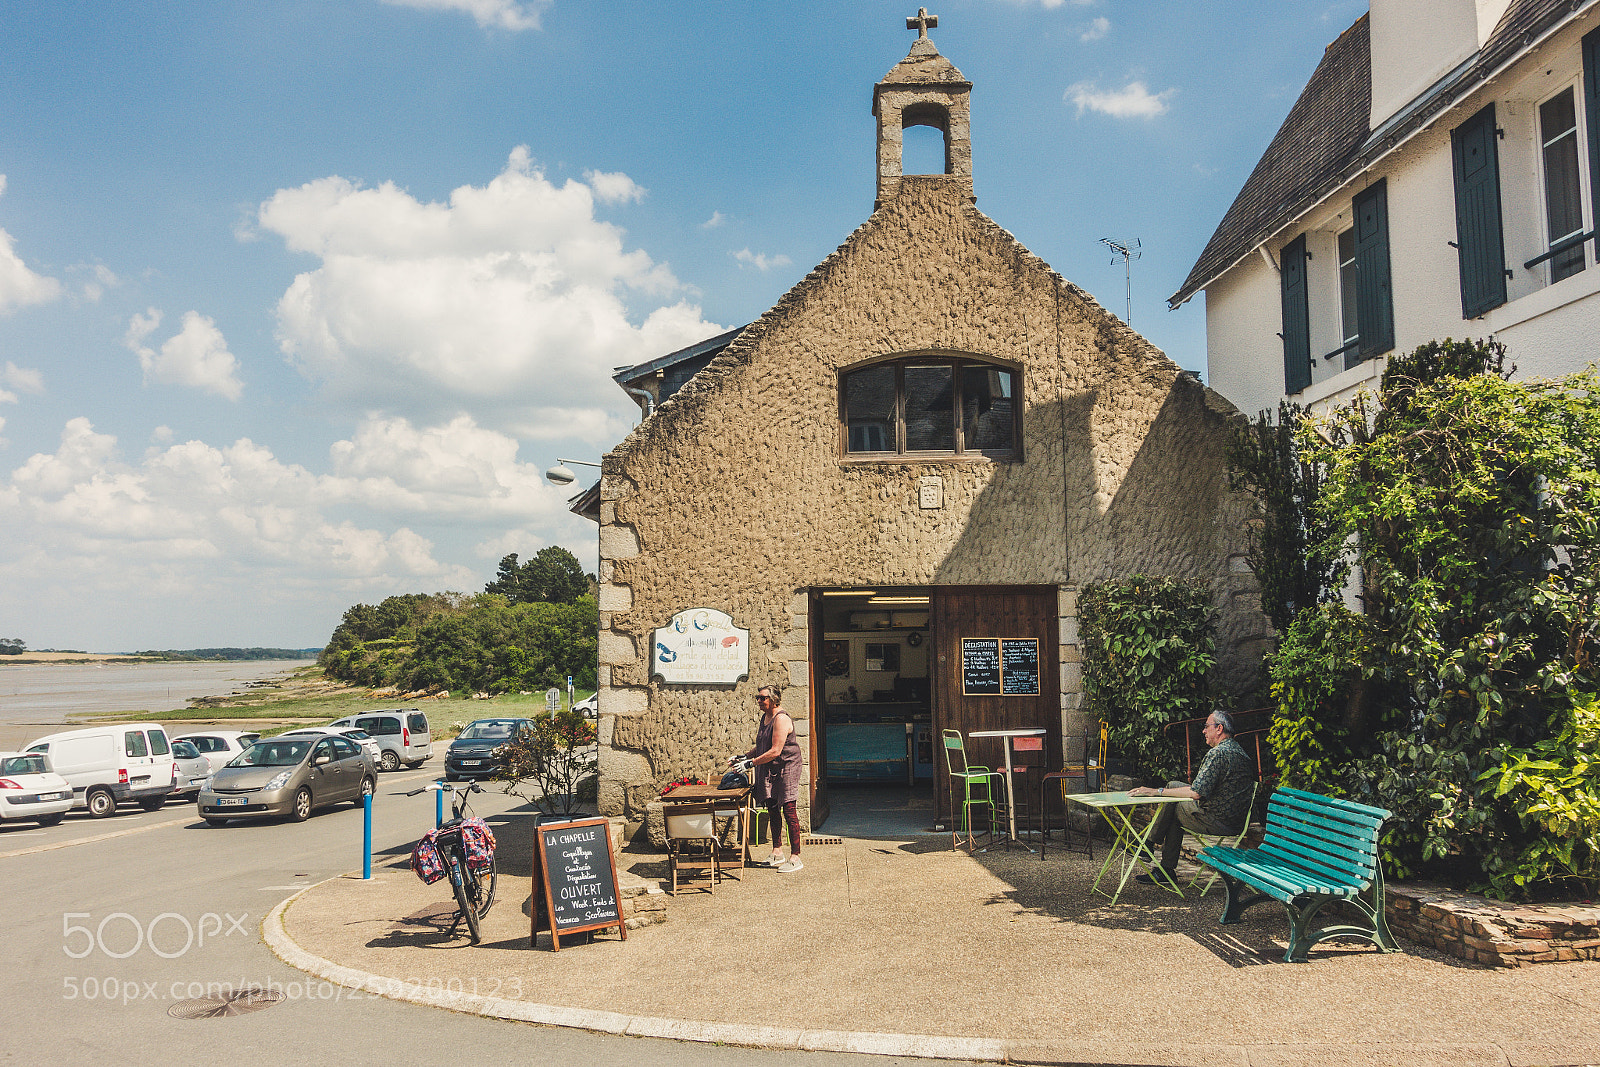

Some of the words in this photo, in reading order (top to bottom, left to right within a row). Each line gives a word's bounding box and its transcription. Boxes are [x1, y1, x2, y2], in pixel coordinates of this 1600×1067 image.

[547, 836, 557, 846] LA
[560, 832, 595, 844] CHAPELLE
[560, 883, 602, 899] OUVERT
